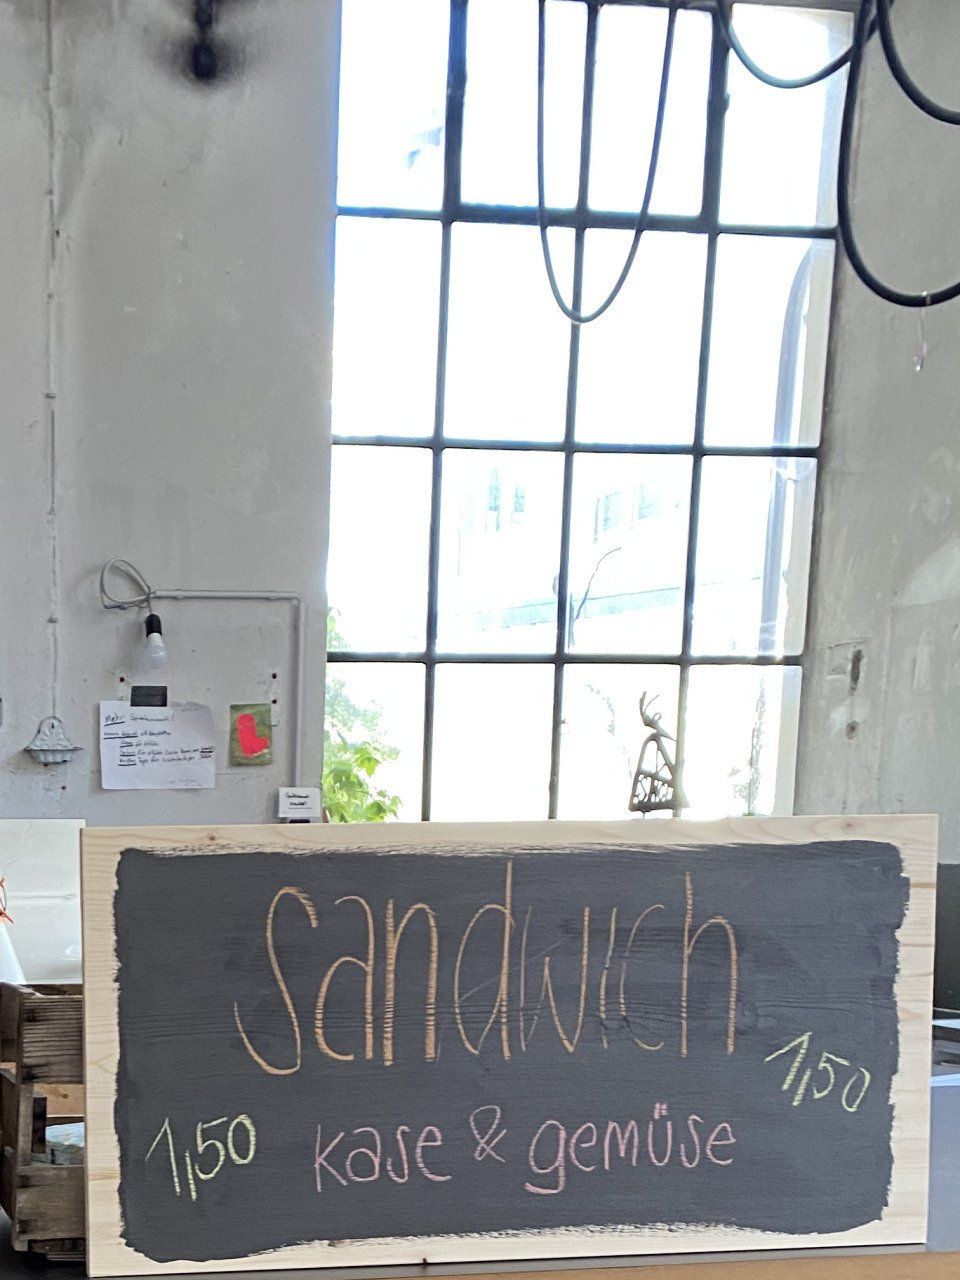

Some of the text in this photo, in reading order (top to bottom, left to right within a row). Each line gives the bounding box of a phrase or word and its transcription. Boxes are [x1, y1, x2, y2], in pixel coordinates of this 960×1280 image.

[764, 1031, 871, 1112] 1,50
[145, 1114, 256, 1201] 1,50
[469, 1105, 507, 1162] &
[524, 1103, 736, 1194] gemüse
